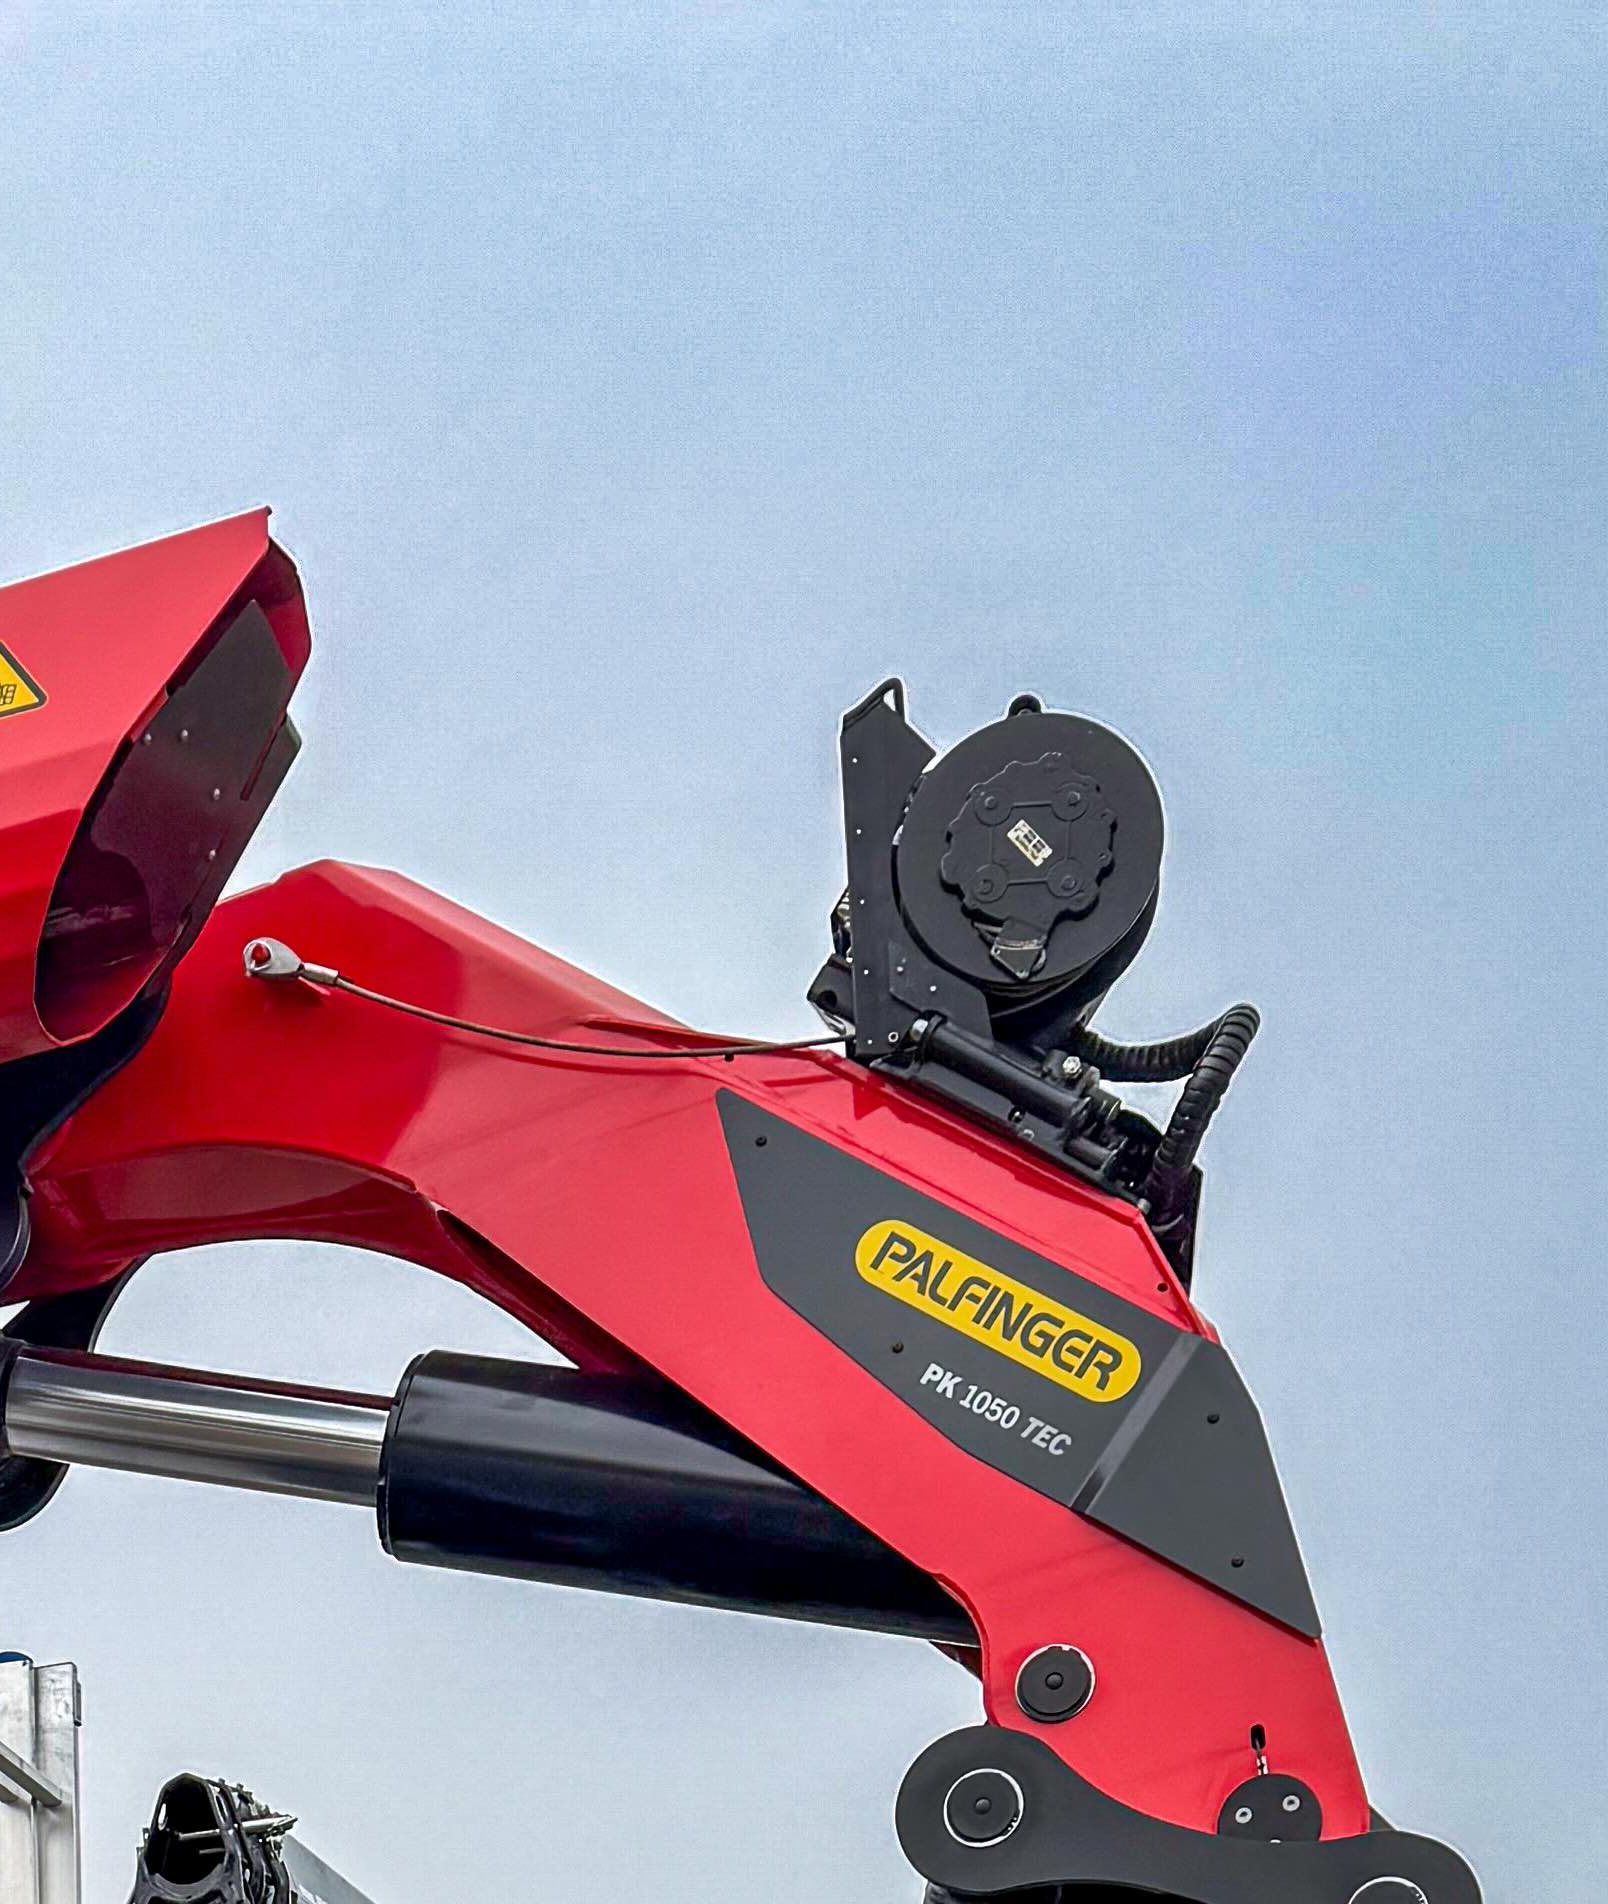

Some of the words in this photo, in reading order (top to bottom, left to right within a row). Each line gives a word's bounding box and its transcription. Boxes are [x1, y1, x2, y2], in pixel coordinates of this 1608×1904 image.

[869, 1230, 1123, 1392] PALFINGER
[919, 1362, 959, 1399] PK
[958, 1384, 1021, 1430] 1050
[1019, 1416, 1073, 1457] TEC
